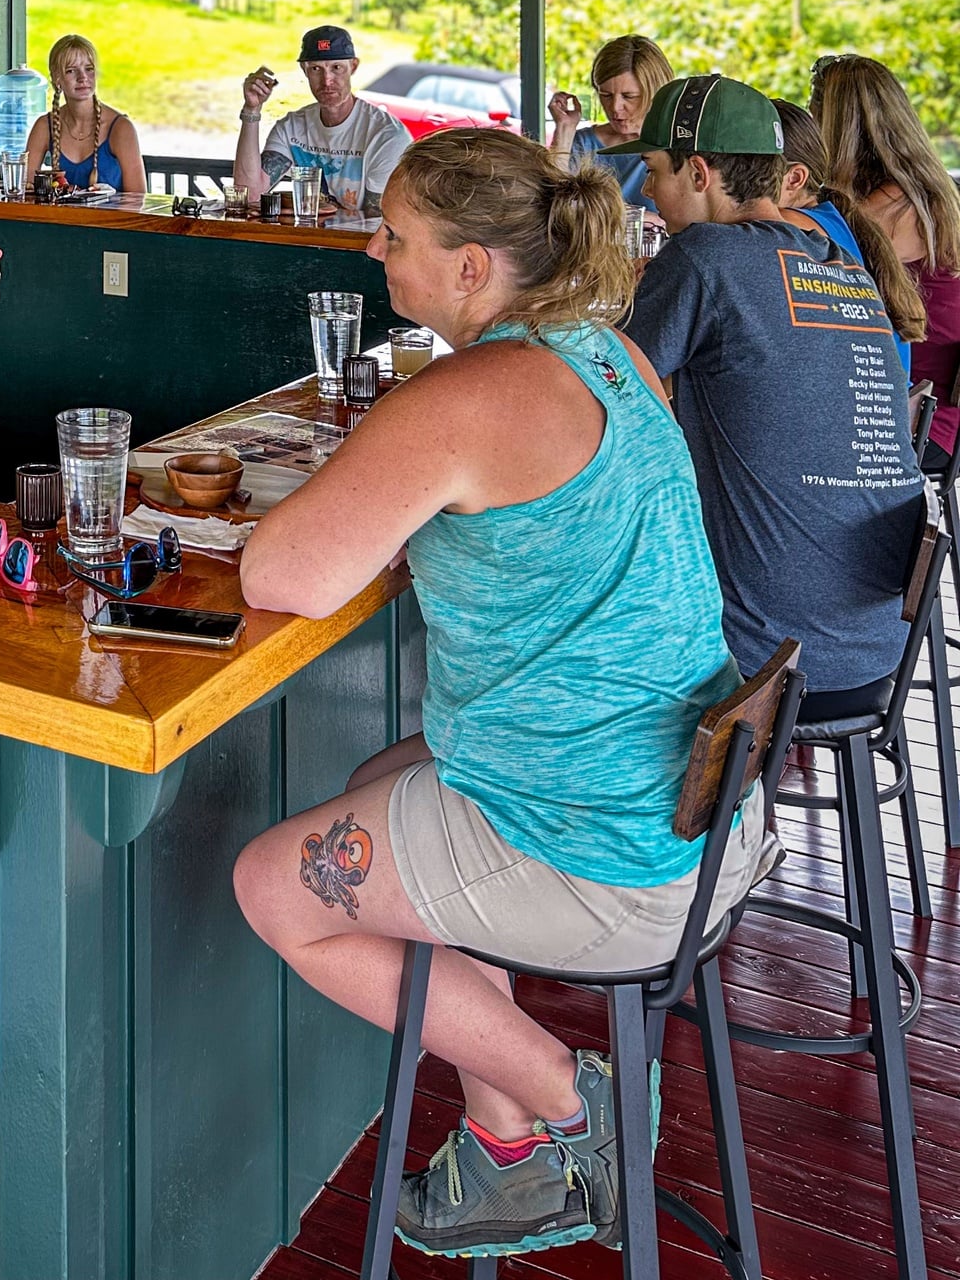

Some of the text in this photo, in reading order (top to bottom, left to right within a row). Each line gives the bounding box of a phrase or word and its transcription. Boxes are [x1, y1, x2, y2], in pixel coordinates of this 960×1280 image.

[839, 302, 869, 320] 2023
[851, 343, 867, 353] Gene
[853, 355, 869, 366] Gary
[856, 367, 869, 377] Pau
[848, 379, 868, 390] Becky
[855, 391, 873, 401] David
[856, 404, 892, 416] Gene Keady
[853, 416, 869, 426] Dirk
[856, 429, 896, 439] Tony Parker
[851, 441, 874, 452] Gregg
[858, 454, 872, 463] Jim
[856, 466, 904, 476] Dwyane Wade
[801, 475, 825, 485] 1976
[827, 476, 864, 487] Women's
[864, 478, 891, 489] Olympic
